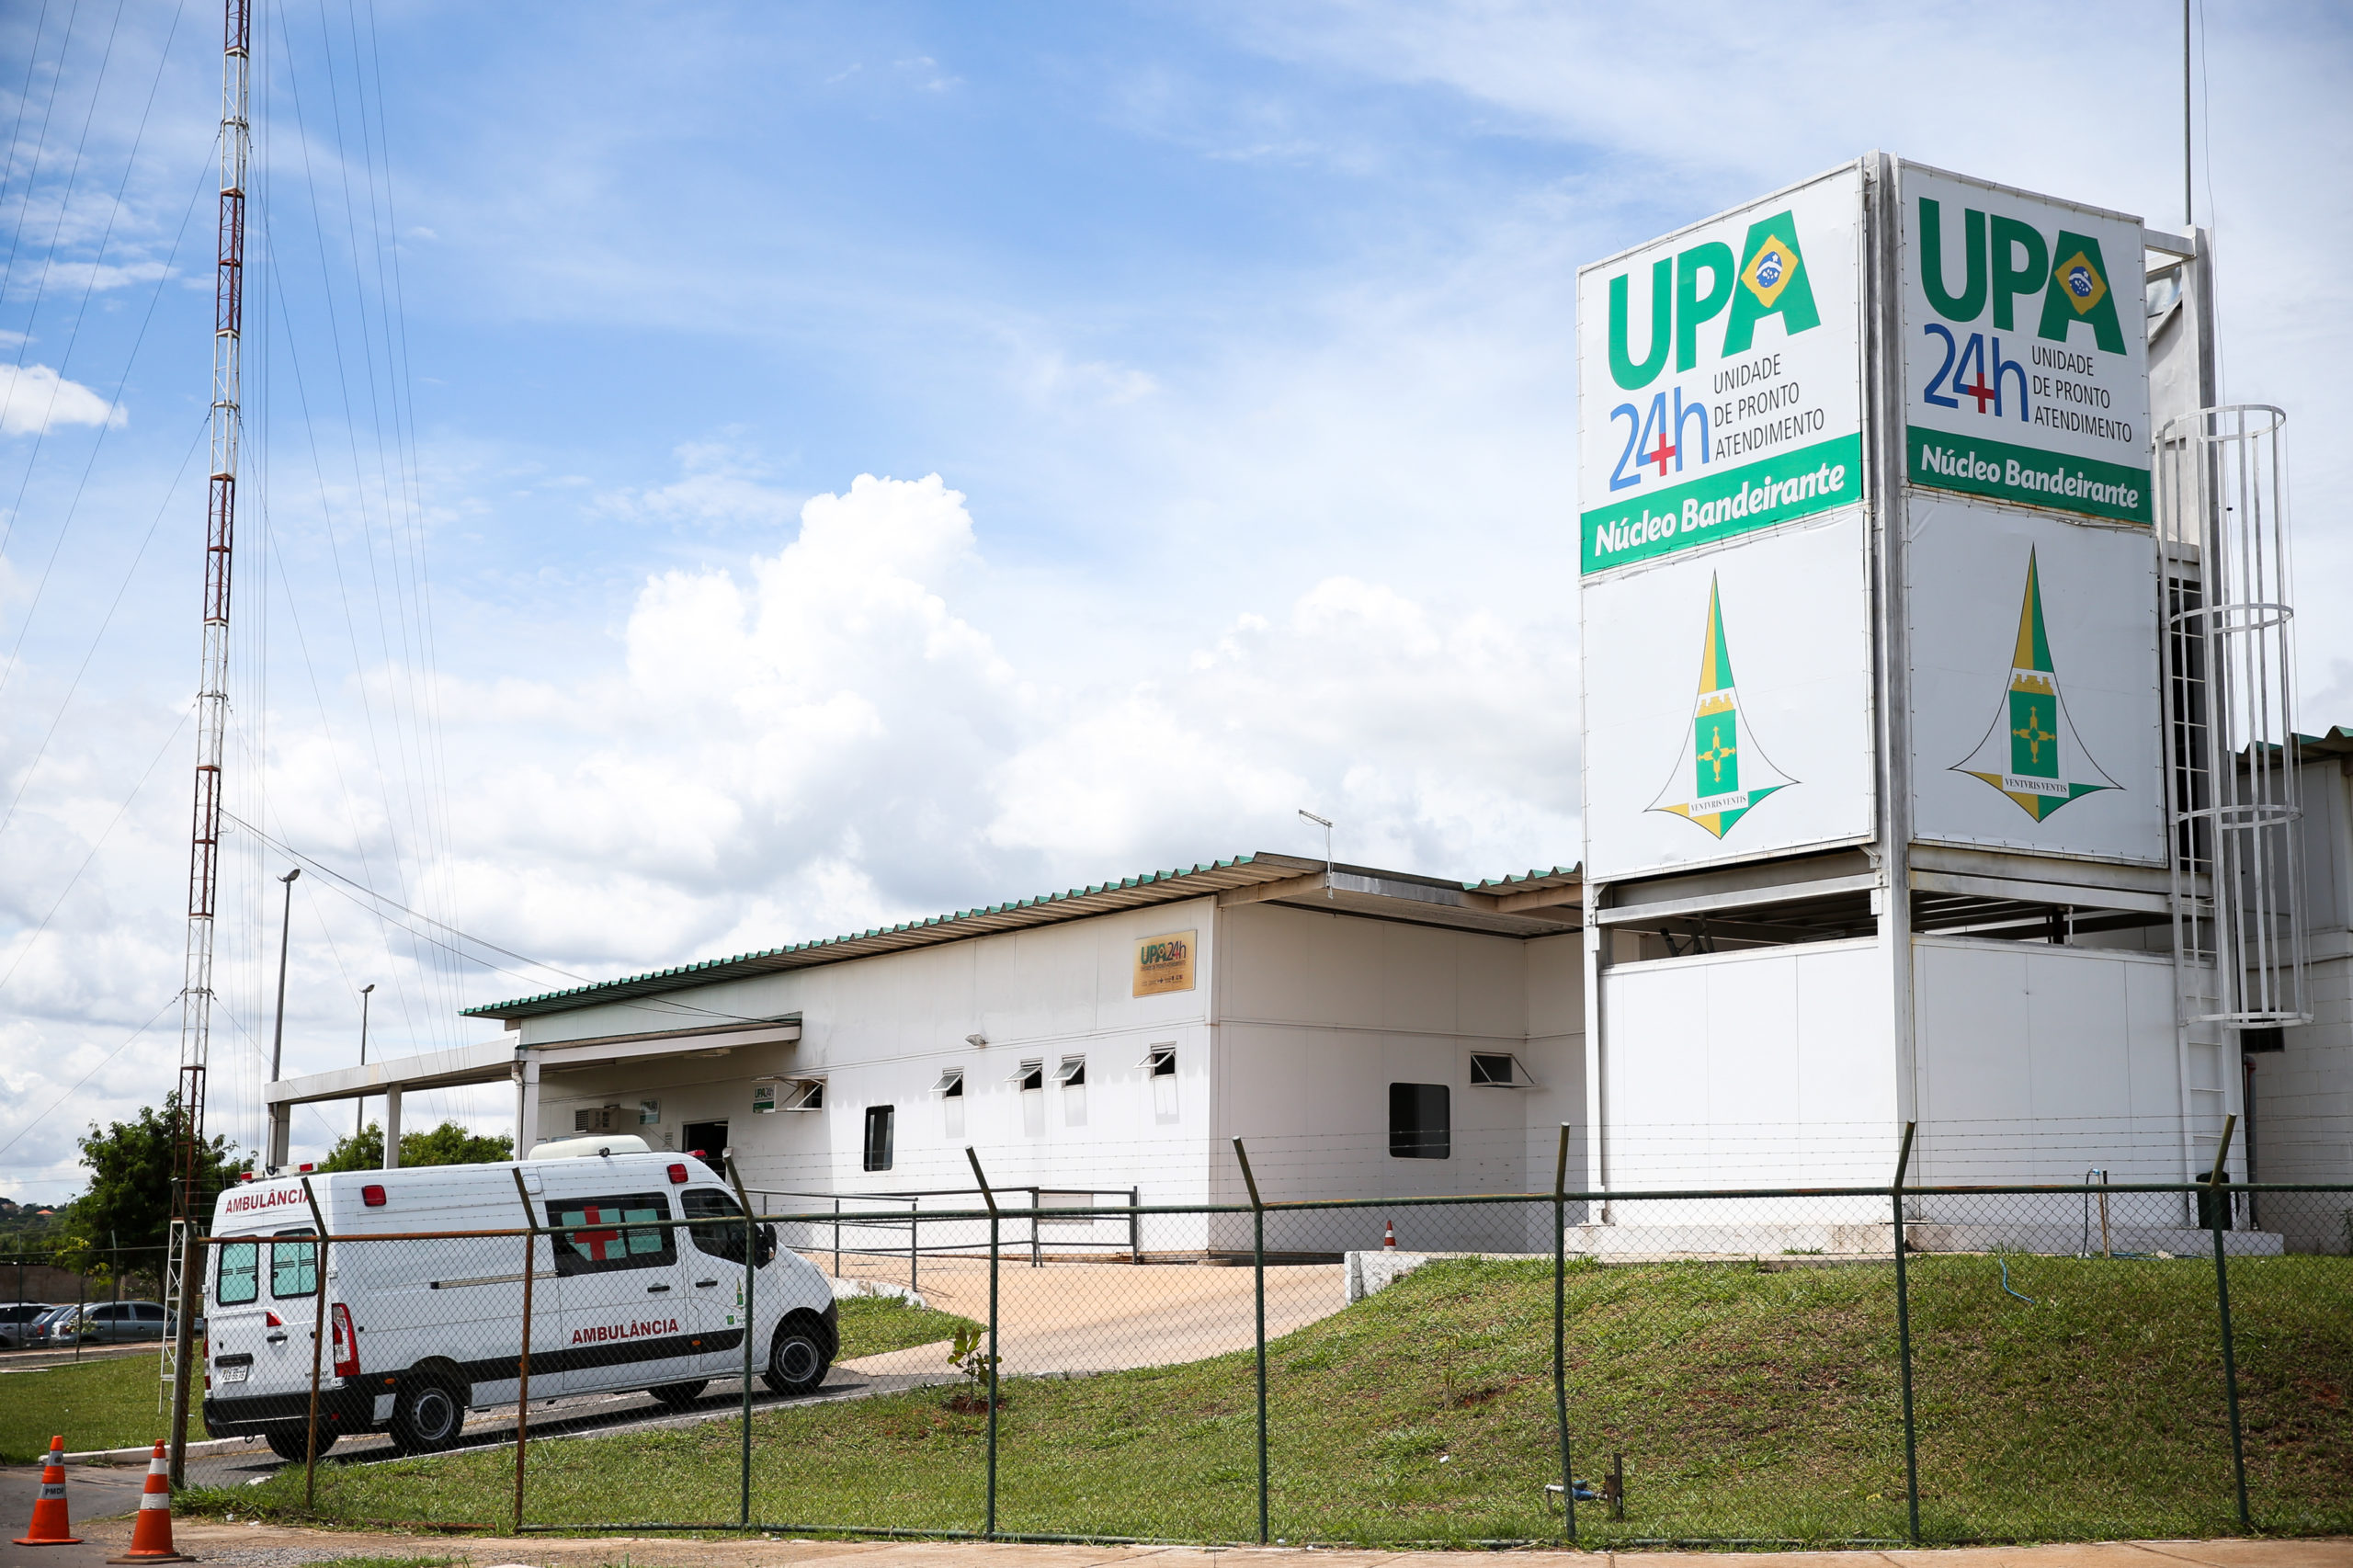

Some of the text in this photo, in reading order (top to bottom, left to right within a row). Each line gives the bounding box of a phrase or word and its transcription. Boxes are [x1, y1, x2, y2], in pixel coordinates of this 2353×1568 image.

[1918, 197, 2127, 356] UPA
[1608, 210, 1821, 391] UPA
[1713, 353, 1781, 394] UNIDADE
[1924, 323, 2029, 423] 24h
[2031, 345, 2094, 377] UNIDADE
[1713, 381, 1800, 427] DE PRONTO
[2032, 375, 2110, 409] DE PRONTO
[1609, 386, 1710, 492] 24h
[1715, 408, 1824, 460] ATENDIMENTO
[2034, 405, 2131, 443] ATENDIMENTO
[1921, 443, 2139, 508] Núcleo Bandeirante
[1595, 462, 1845, 557] Núcleo Bandeirante
[1723, 794, 1746, 806] VENTIS
[2041, 782, 2067, 793] VENTIS
[572, 1318, 679, 1345] AMBULÂNCIA
